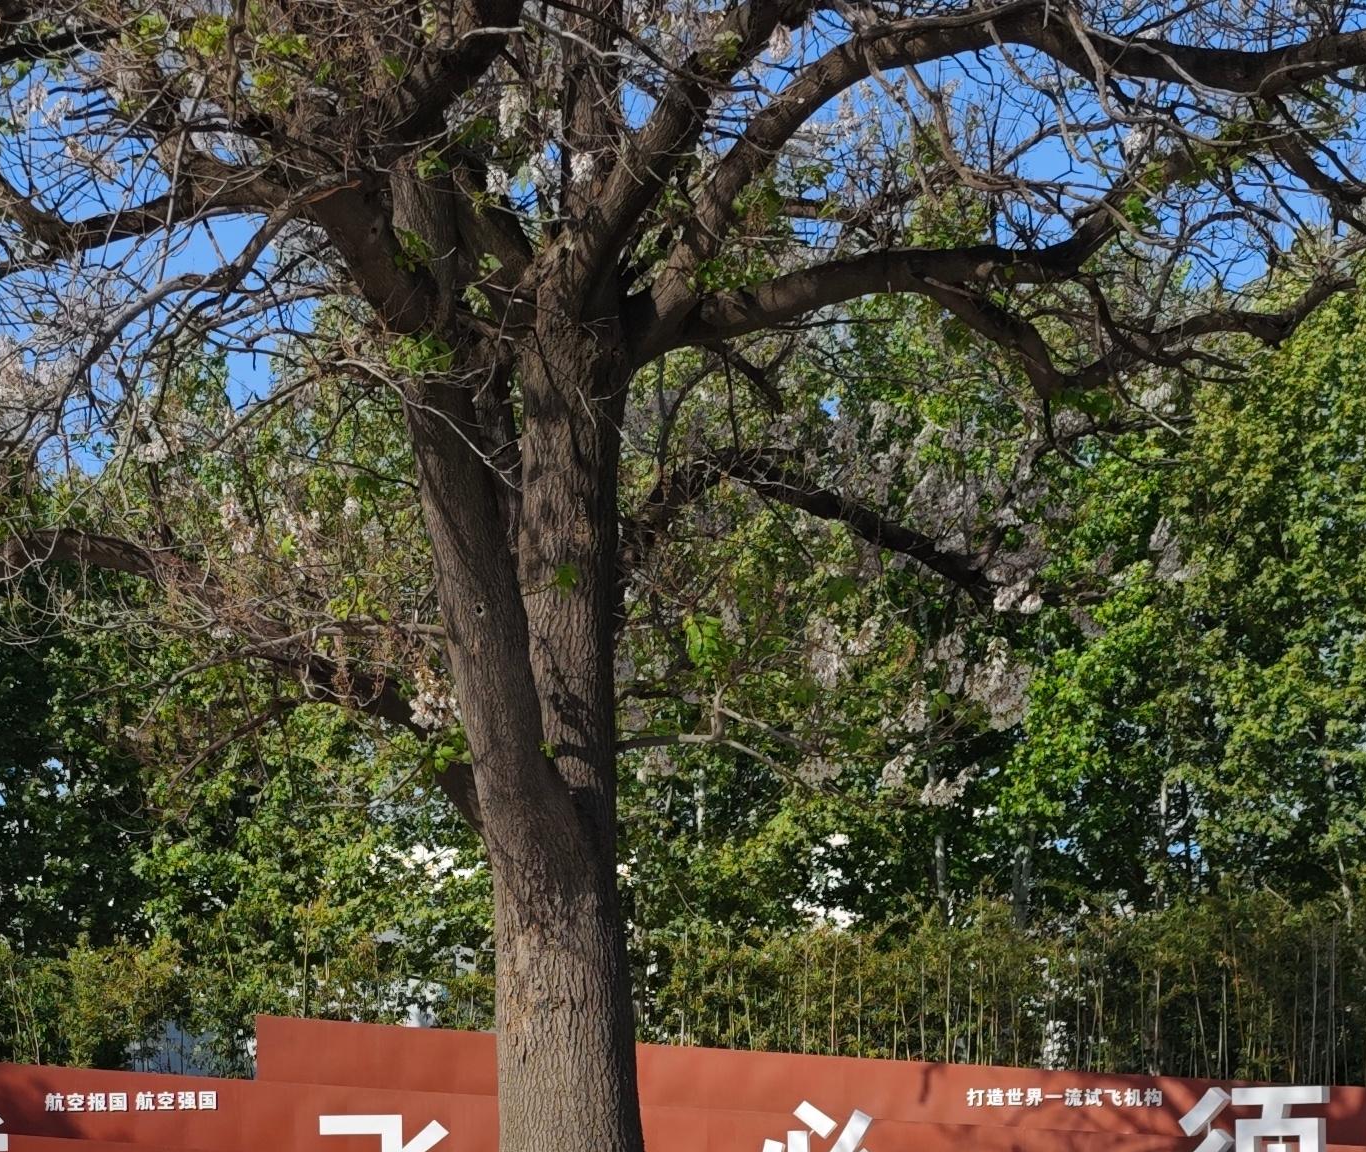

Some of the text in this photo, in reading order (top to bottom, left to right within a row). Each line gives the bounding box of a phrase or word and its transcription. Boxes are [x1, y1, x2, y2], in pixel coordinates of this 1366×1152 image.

[44, 1090, 218, 1112] 航空报国 航空强国
[967, 1088, 1163, 1107] 打造世界一流试飞机构
